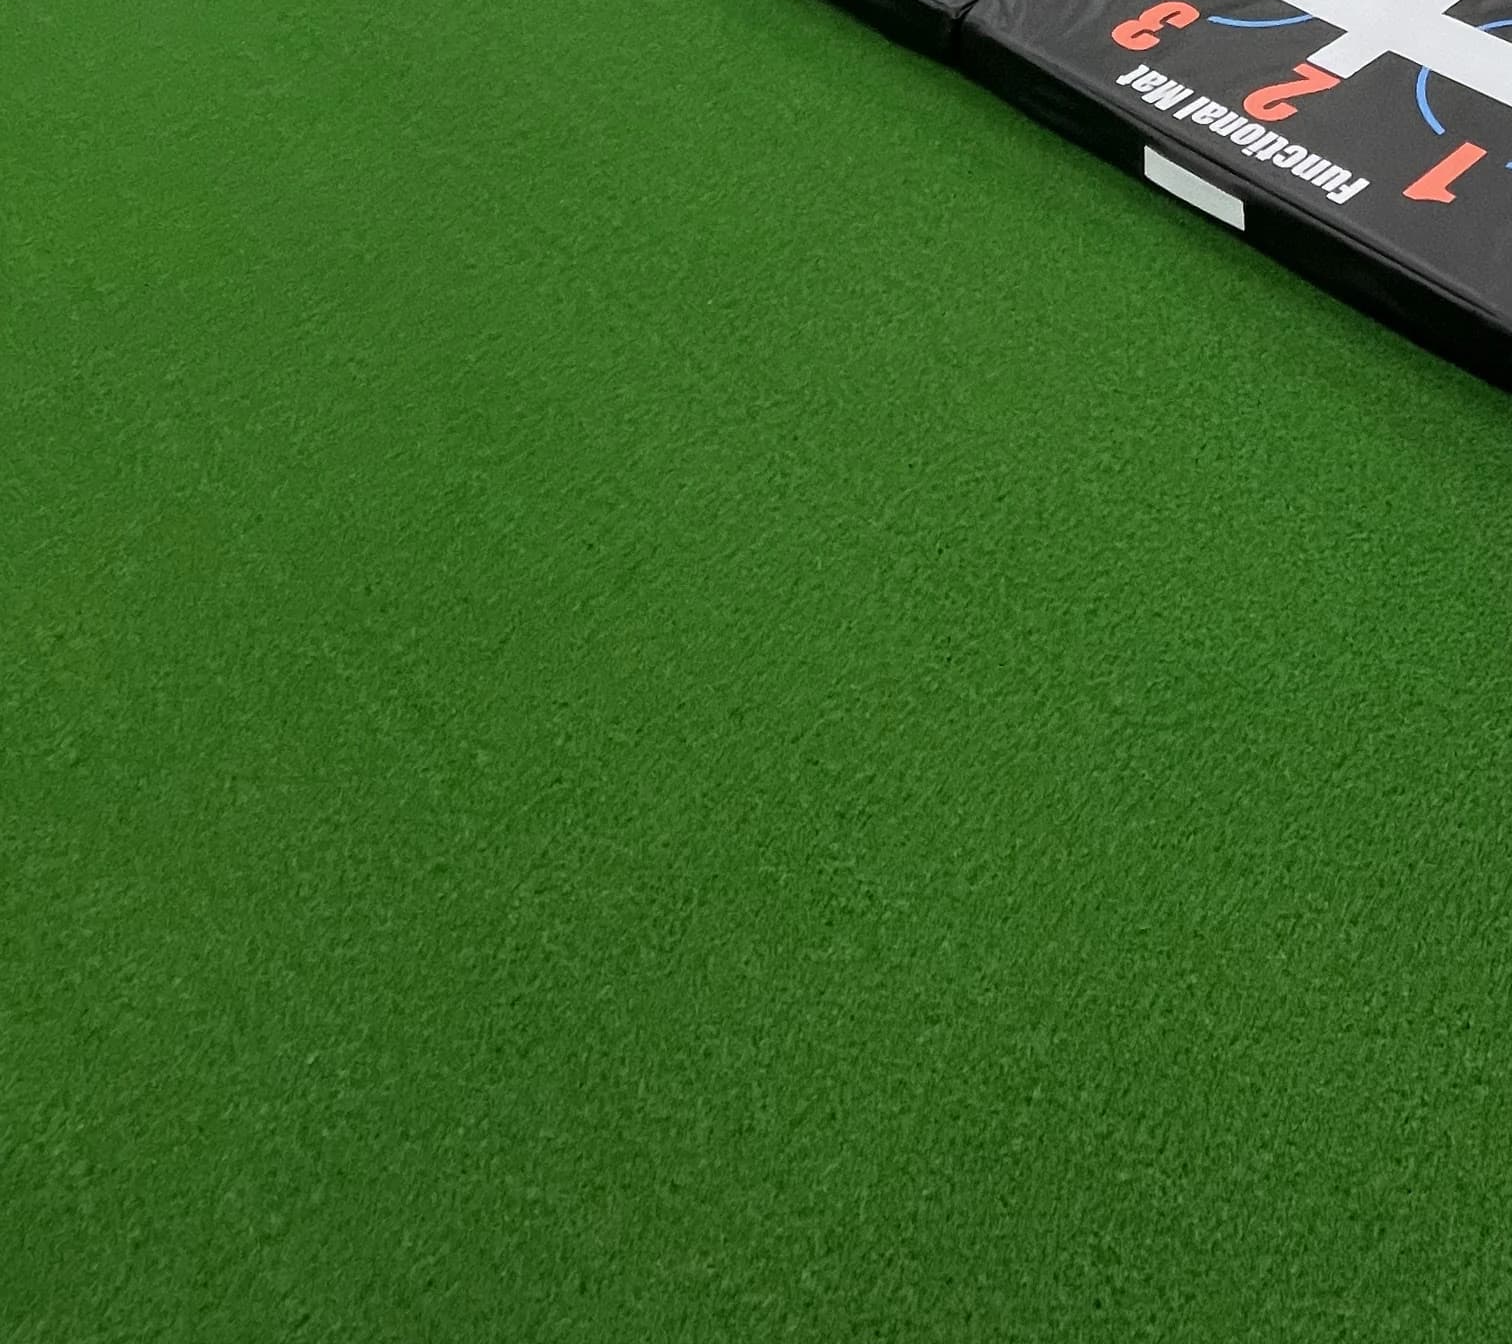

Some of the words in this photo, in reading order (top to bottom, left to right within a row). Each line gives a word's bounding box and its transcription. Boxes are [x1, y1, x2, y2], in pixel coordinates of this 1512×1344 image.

[1110, 0, 1201, 52] 3
[1115, 63, 1195, 112] Mat
[1242, 62, 1342, 122] 2
[1171, 95, 1371, 205] Functional
[1402, 140, 1489, 205] 1
